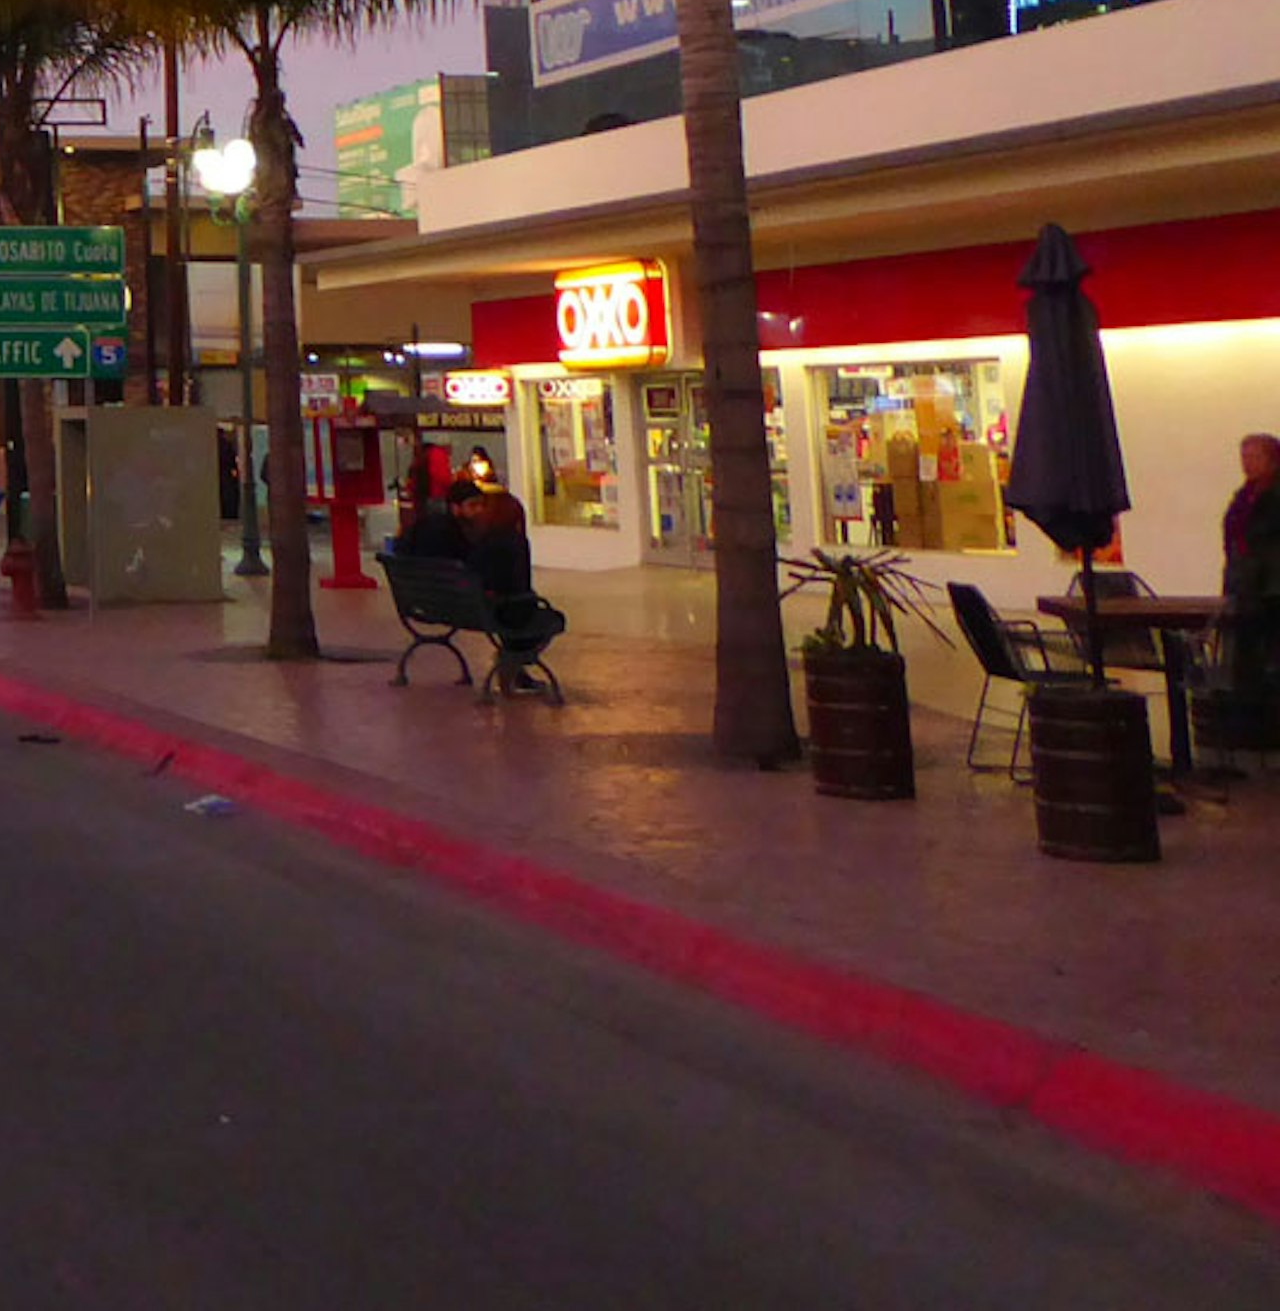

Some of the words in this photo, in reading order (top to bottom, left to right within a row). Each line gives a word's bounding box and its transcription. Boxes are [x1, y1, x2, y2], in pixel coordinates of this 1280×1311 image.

[42, 291, 58, 313] DE
[65, 291, 120, 313] TIJUANA
[557, 282, 648, 350] OXXO
[100, 345, 117, 364] 5
